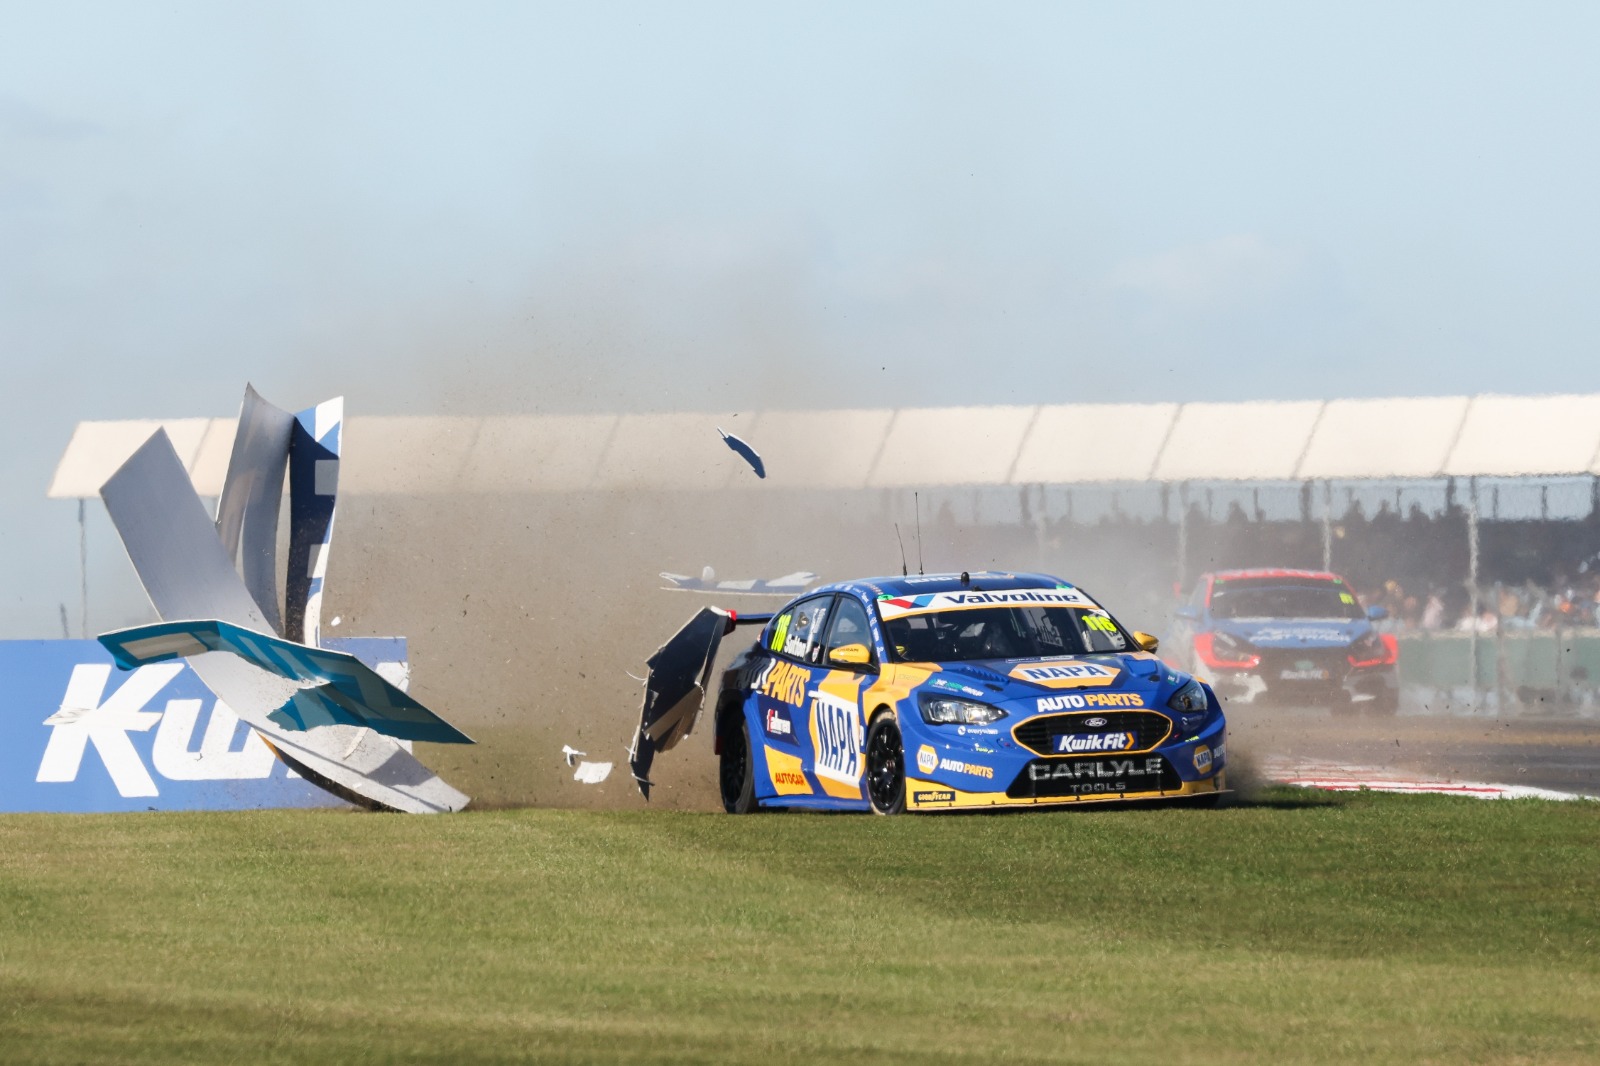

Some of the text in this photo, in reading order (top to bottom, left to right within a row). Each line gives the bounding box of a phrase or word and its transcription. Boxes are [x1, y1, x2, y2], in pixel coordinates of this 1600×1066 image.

[944, 591, 1079, 605] Valvoline
[1081, 615, 1117, 632] 116
[771, 614, 791, 652] 116
[1023, 666, 1108, 679] NAPA
[764, 660, 811, 708] PARTS
[1037, 693, 1144, 712] AUTO PARTS
[817, 702, 857, 776] NAPA
[920, 752, 934, 767] NAPA
[1196, 751, 1211, 767] NAPA
[940, 758, 994, 779] AUTO PARTS
[1029, 758, 1164, 781] CARLYLE
[775, 772, 805, 786] AUTOCAR
[1070, 782, 1127, 793] TOOLS
